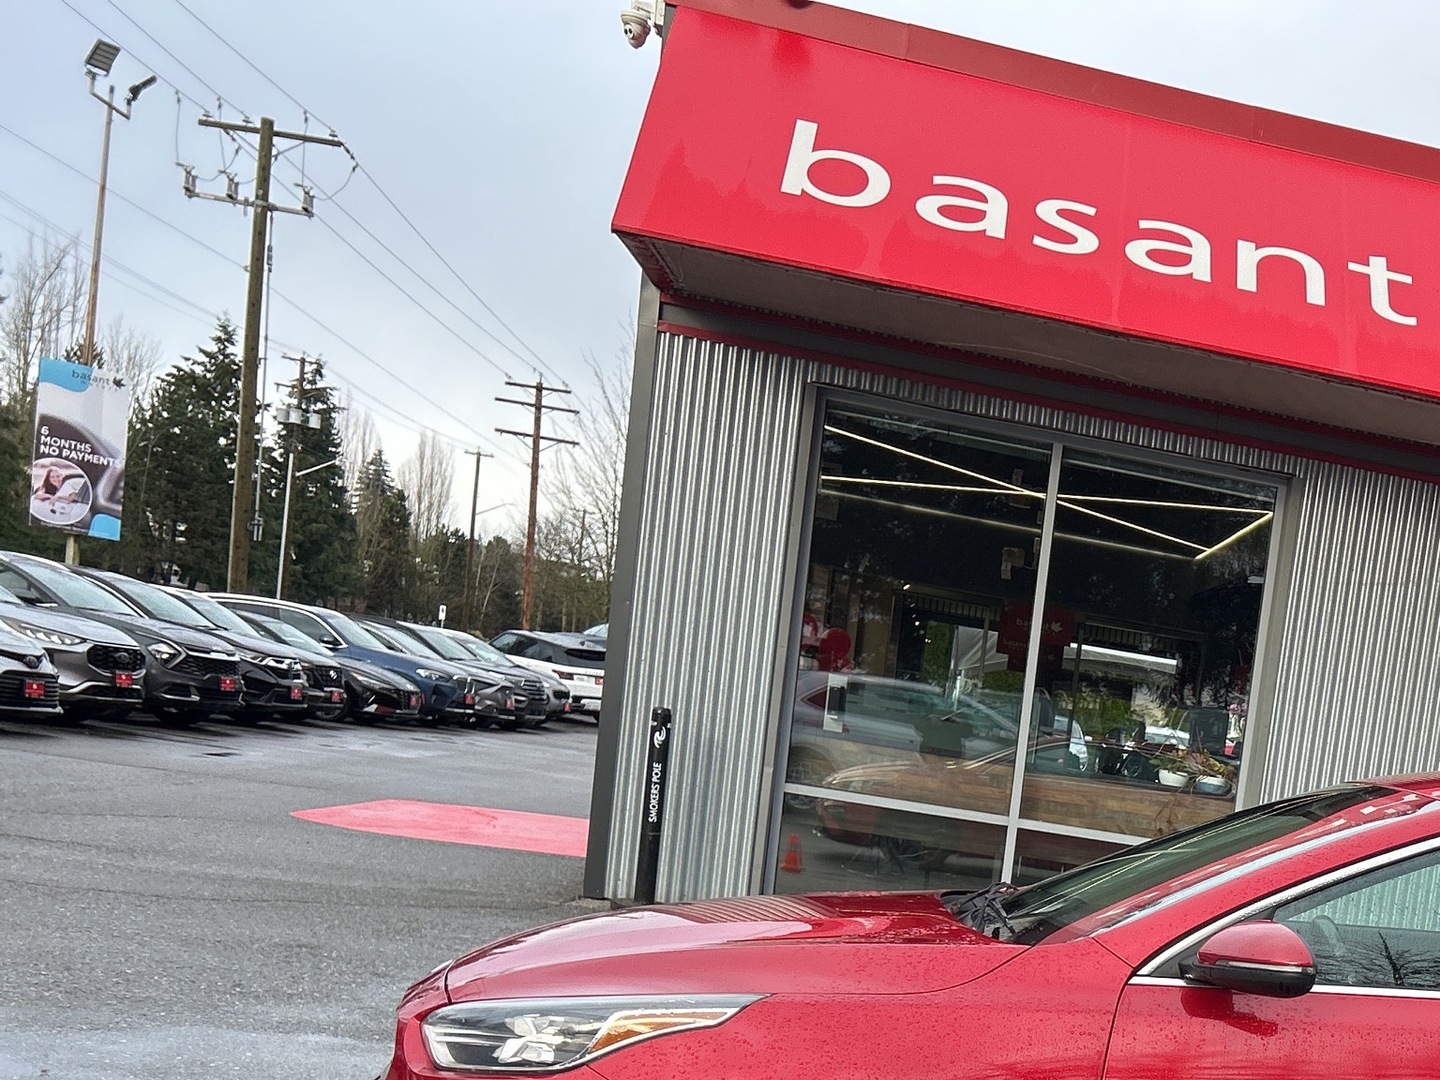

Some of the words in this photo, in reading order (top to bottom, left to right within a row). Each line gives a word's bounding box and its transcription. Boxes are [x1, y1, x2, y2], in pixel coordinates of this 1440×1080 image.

[779, 119, 1418, 327] basant
[72, 369, 110, 385] basant
[40, 426, 49, 435] 6
[40, 435, 92, 453] MONTHS
[40, 445, 59, 456] NO
[652, 762, 662, 783] POLE
[648, 783, 660, 823] SMOKERS
